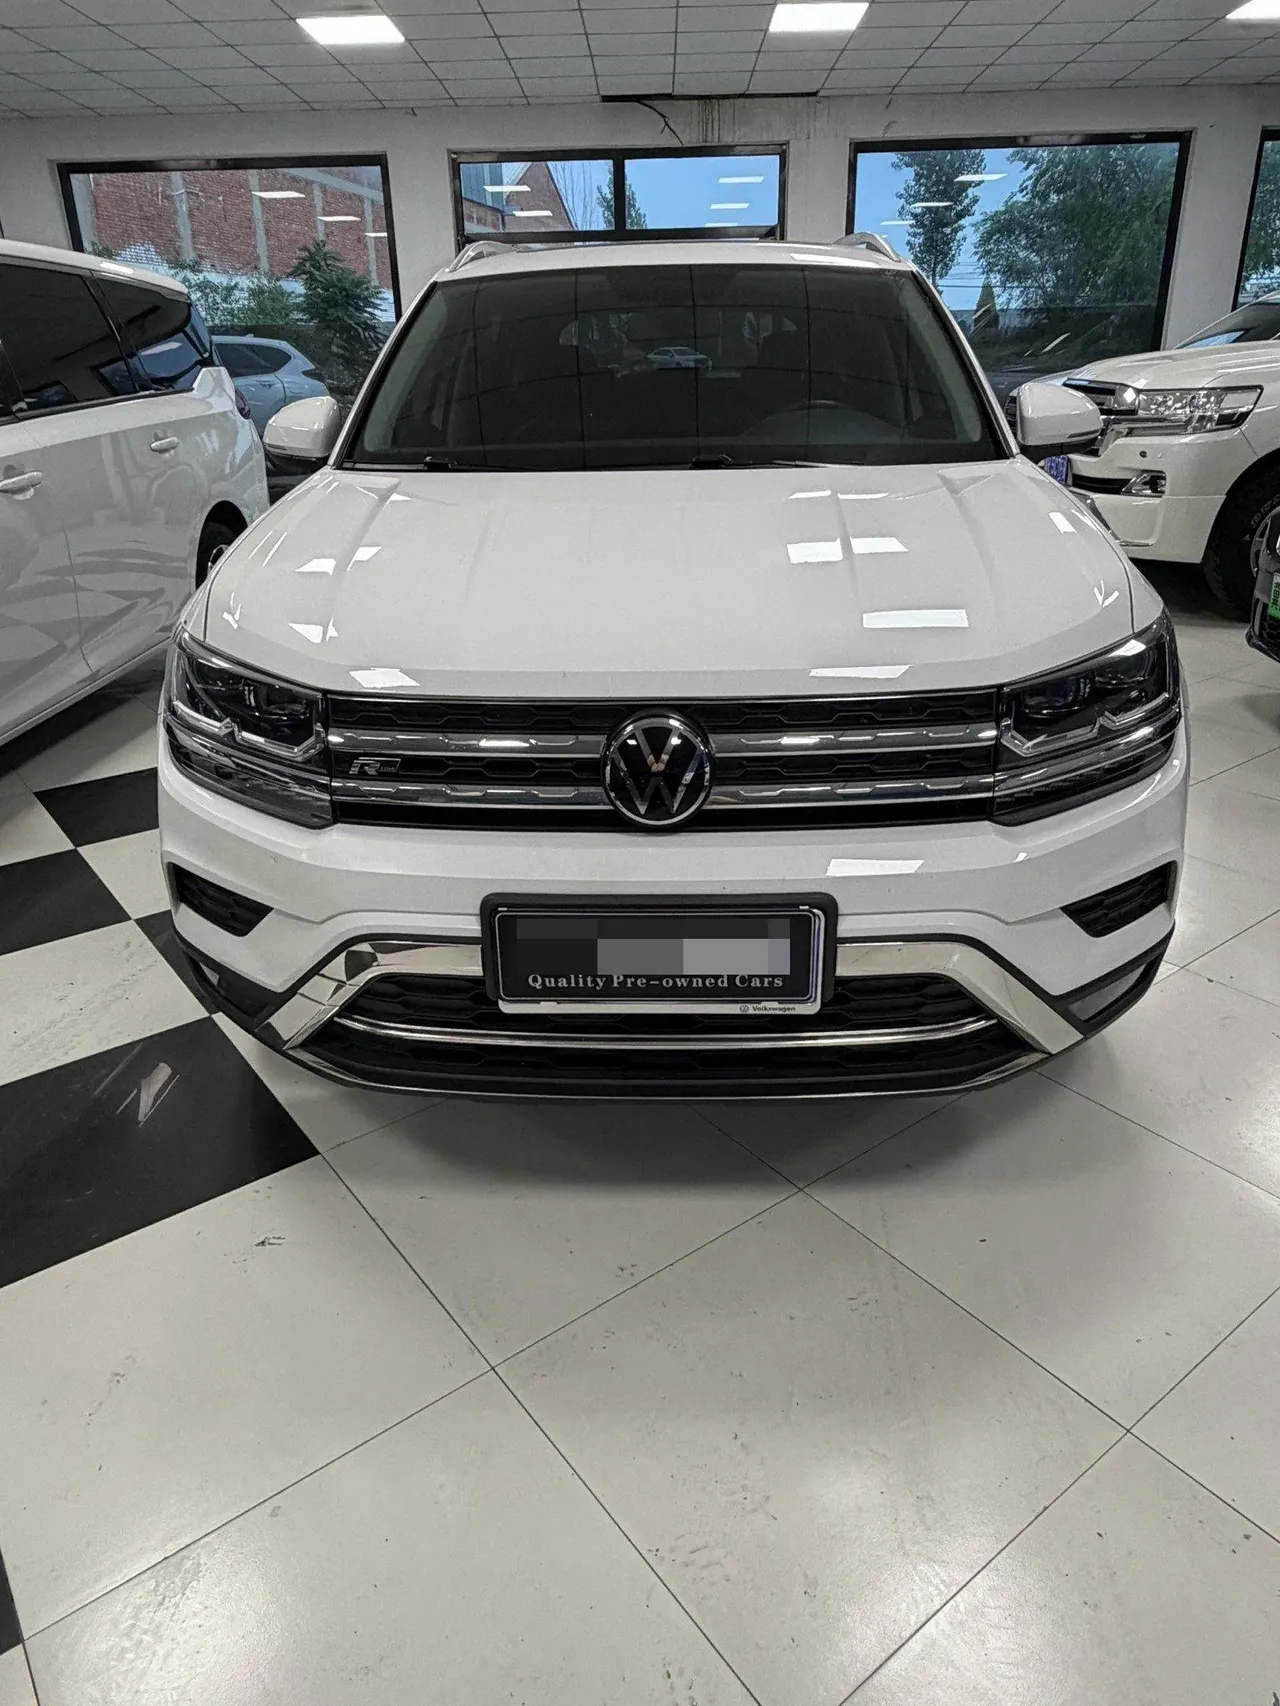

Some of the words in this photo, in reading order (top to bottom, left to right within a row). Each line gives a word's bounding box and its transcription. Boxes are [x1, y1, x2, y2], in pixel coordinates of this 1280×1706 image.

[348, 759, 380, 775] R
[528, 973, 607, 990] Quality
[611, 973, 729, 988] Pre-owned
[735, 973, 784, 988] Cars
[752, 1004, 796, 1013] Volkswagen
